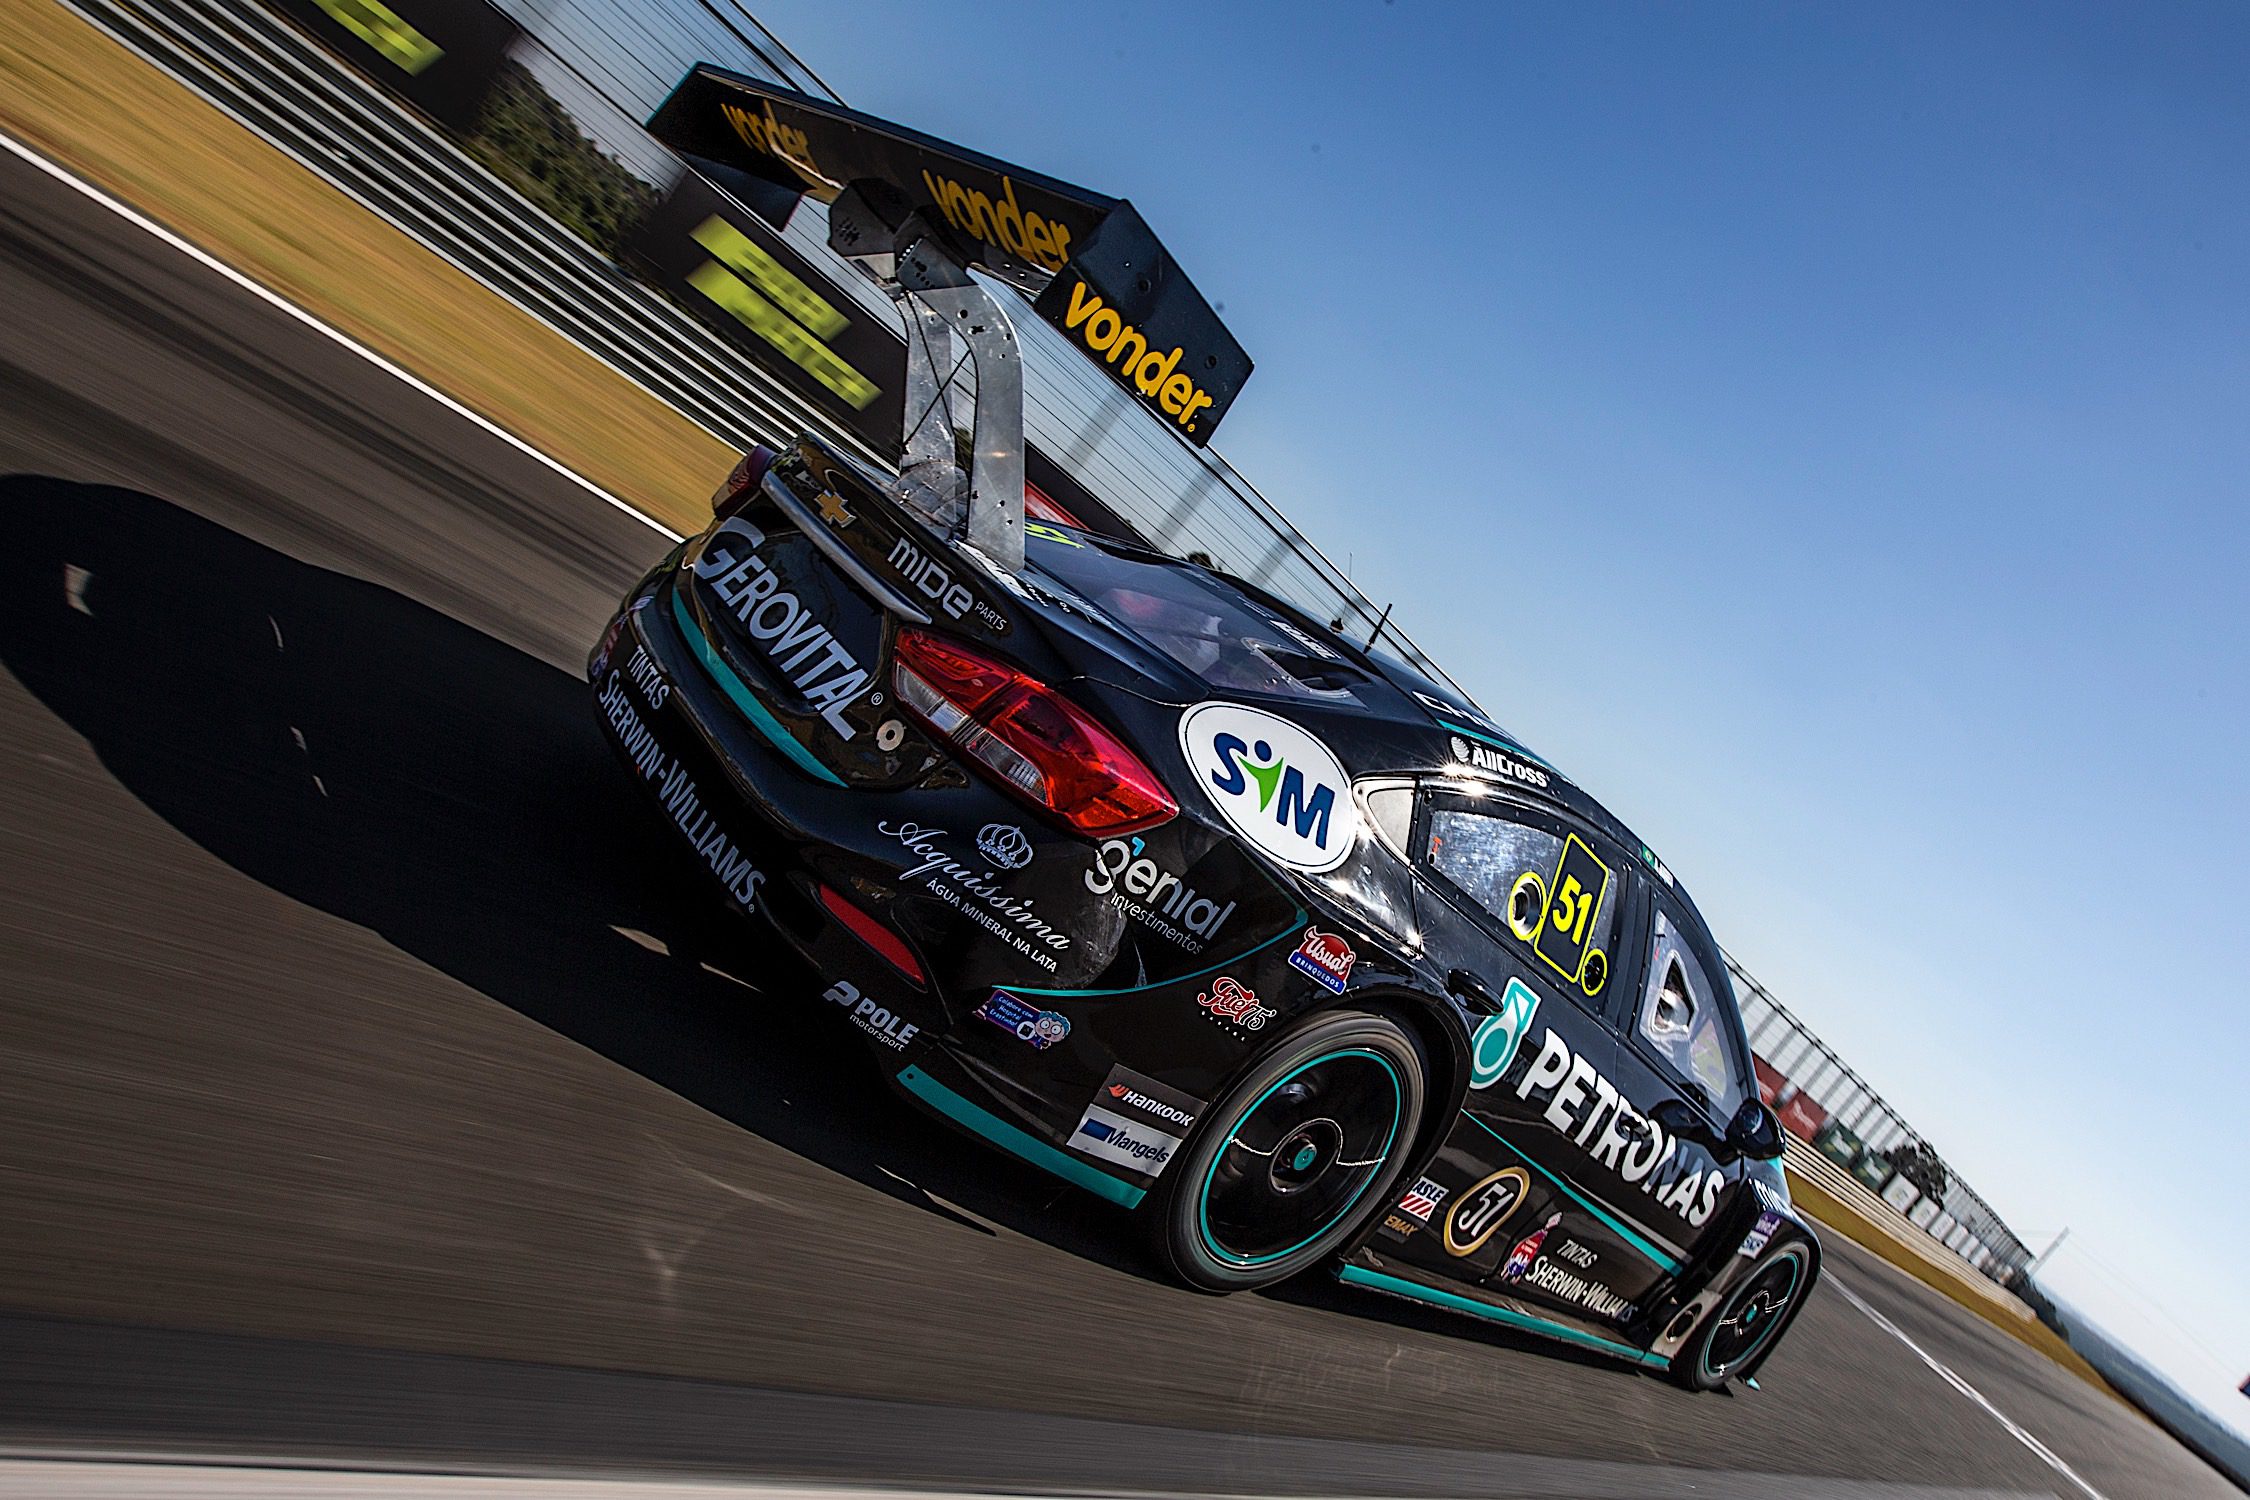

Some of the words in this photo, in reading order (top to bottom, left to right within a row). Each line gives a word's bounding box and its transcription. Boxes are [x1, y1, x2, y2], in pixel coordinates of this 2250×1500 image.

[1066, 282, 1212, 432] vonder.
[694, 517, 869, 741] GEROVITAL
[975, 601, 1007, 631] PARTS
[627, 644, 670, 710] TINTAS
[599, 669, 766, 905] SHERWIN-WILLIAMS
[878, 821, 1072, 950] Acquissima
[1084, 840, 1237, 941] genial
[1552, 874, 1593, 946] 51
[926, 877, 961, 907] ÁGUA
[961, 902, 1012, 943] MINERAL
[1013, 937, 1031, 954] NA
[1031, 949, 1057, 972] LATA
[1110, 892, 1204, 955] investimentos
[1306, 930, 1354, 975] Usual
[1296, 957, 1340, 988] BRINQUEDOS
[849, 1013, 905, 1051] motorsport
[855, 997, 920, 1045] POLE
[1104, 1127, 1170, 1163] Mangels
[1515, 1027, 1725, 1229] PETRONAS
[1412, 1180, 1445, 1203] ASLE
[1458, 1182, 1514, 1238] 51
[1557, 1239, 1598, 1269] TINTAS
